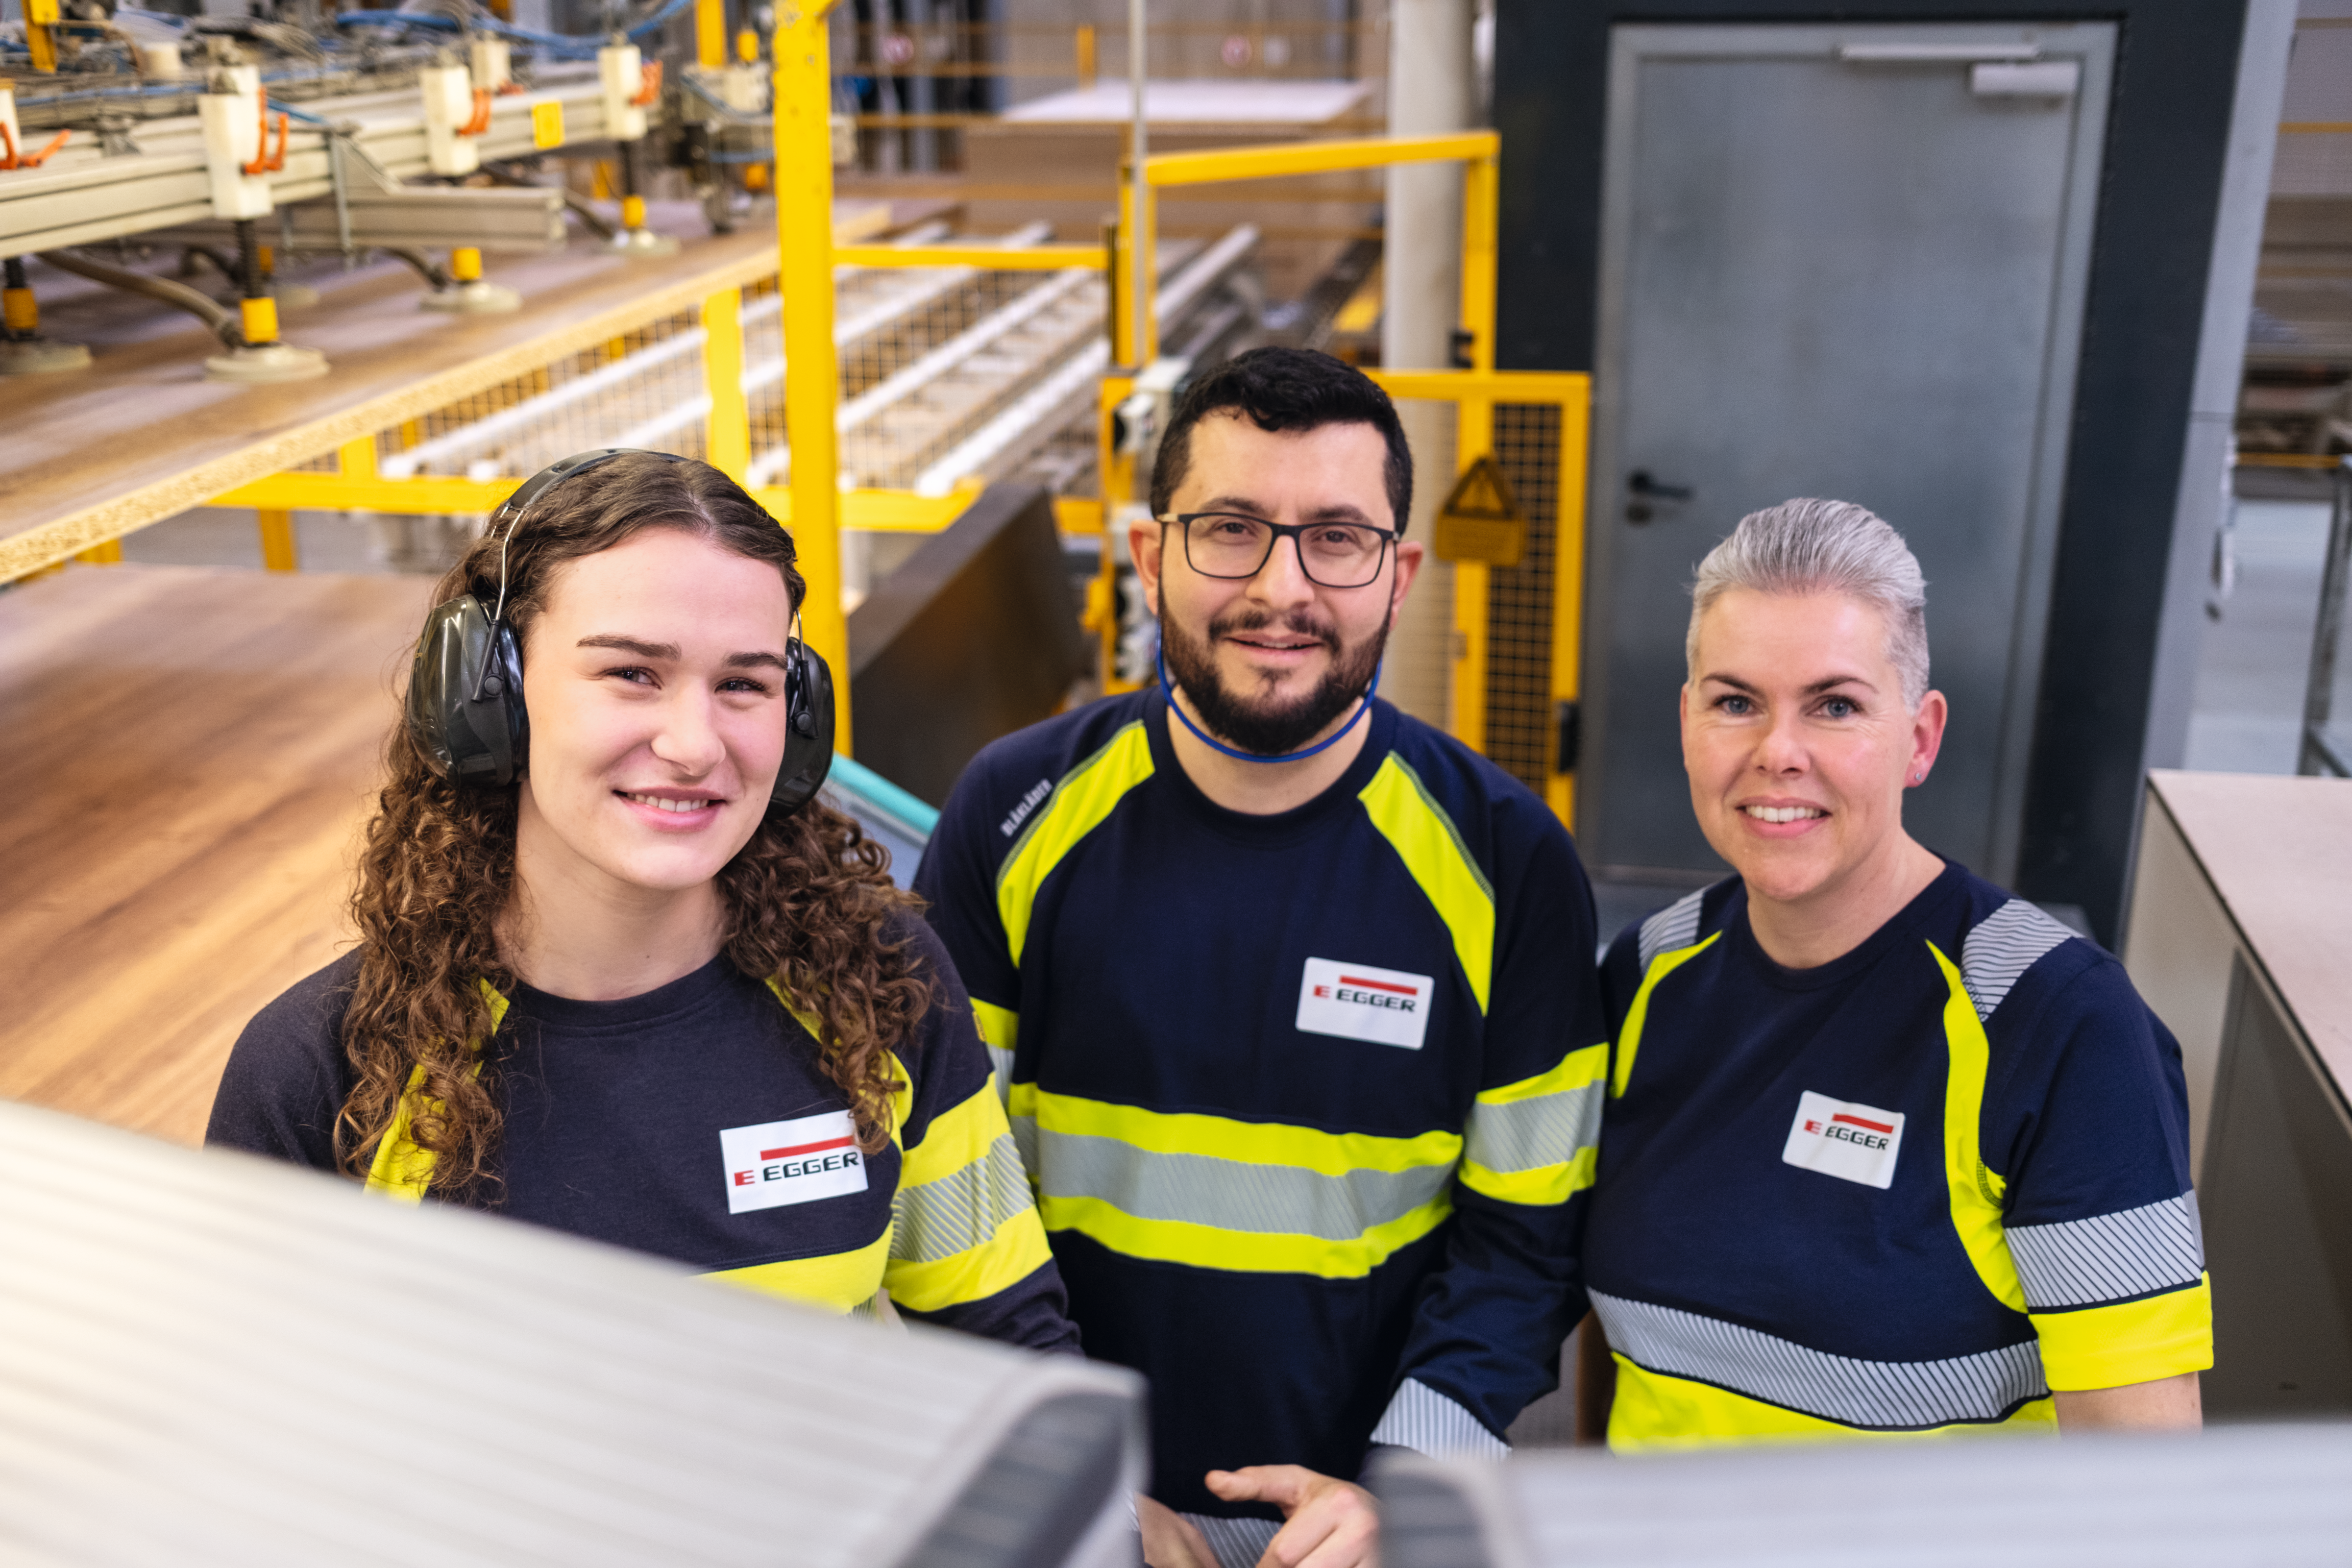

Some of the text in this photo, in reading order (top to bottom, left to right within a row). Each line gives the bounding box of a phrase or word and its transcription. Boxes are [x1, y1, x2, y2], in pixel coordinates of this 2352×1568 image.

[1314, 985, 1416, 1012] E EGGER
[1804, 1119, 1889, 1150] E EGGER
[734, 1152, 860, 1186] E EGGER
